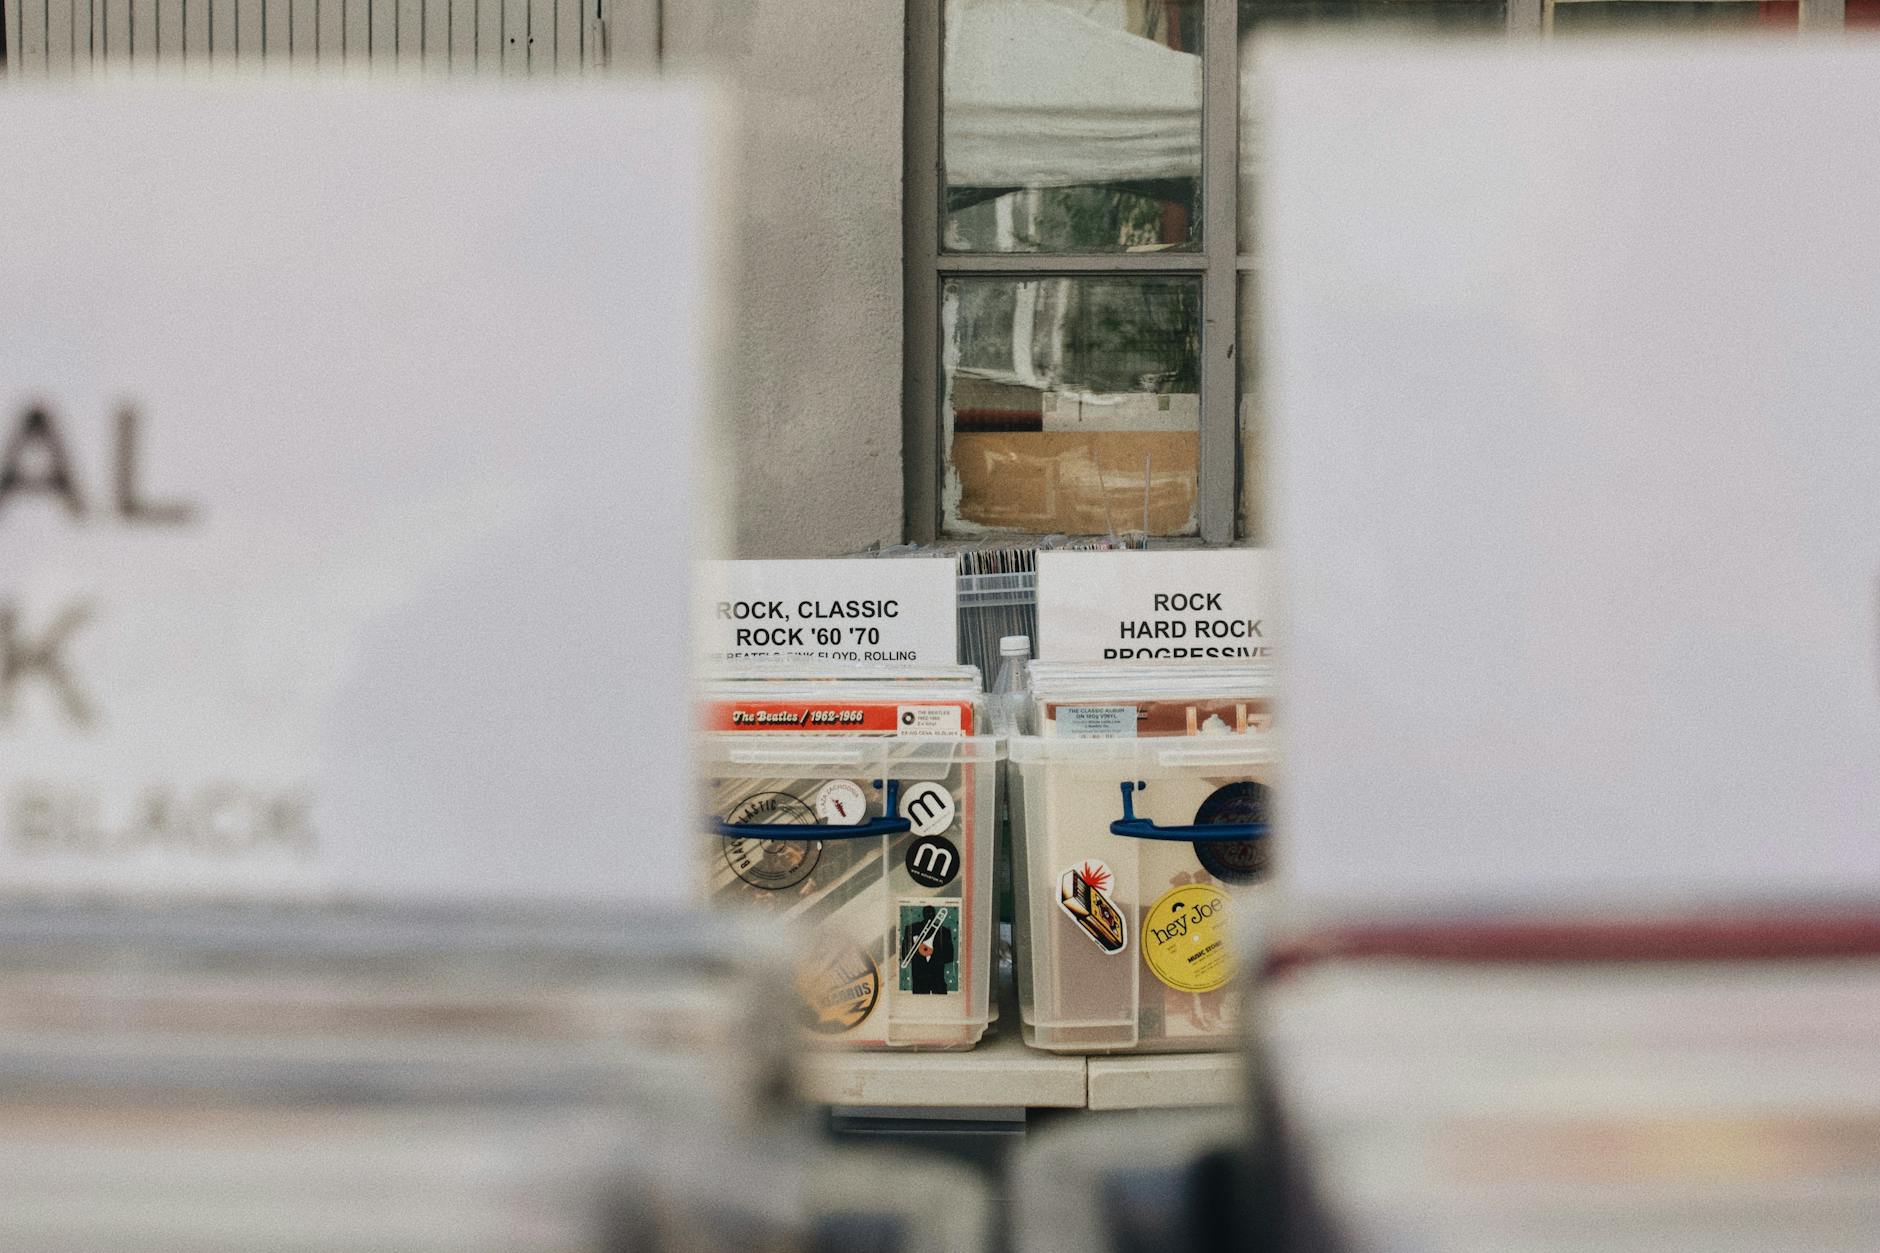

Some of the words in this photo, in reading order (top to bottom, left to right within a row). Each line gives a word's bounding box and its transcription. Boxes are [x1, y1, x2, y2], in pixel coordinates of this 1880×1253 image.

[717, 601, 790, 622] ROCK,
[798, 600, 899, 618] CLASSIC
[1154, 593, 1222, 611] ROCK
[737, 628, 804, 646] ROCK
[811, 627, 842, 645] '60
[850, 627, 880, 645] '70
[1120, 620, 1186, 638] HARD
[1195, 620, 1265, 638] ROCK
[864, 651, 917, 661] ROLLING
[732, 710, 755, 723] The
[757, 710, 798, 723] Beatles
[811, 710, 864, 723] 1962-1966
[1151, 914, 1187, 945] hey
[1191, 898, 1223, 924] Joe
